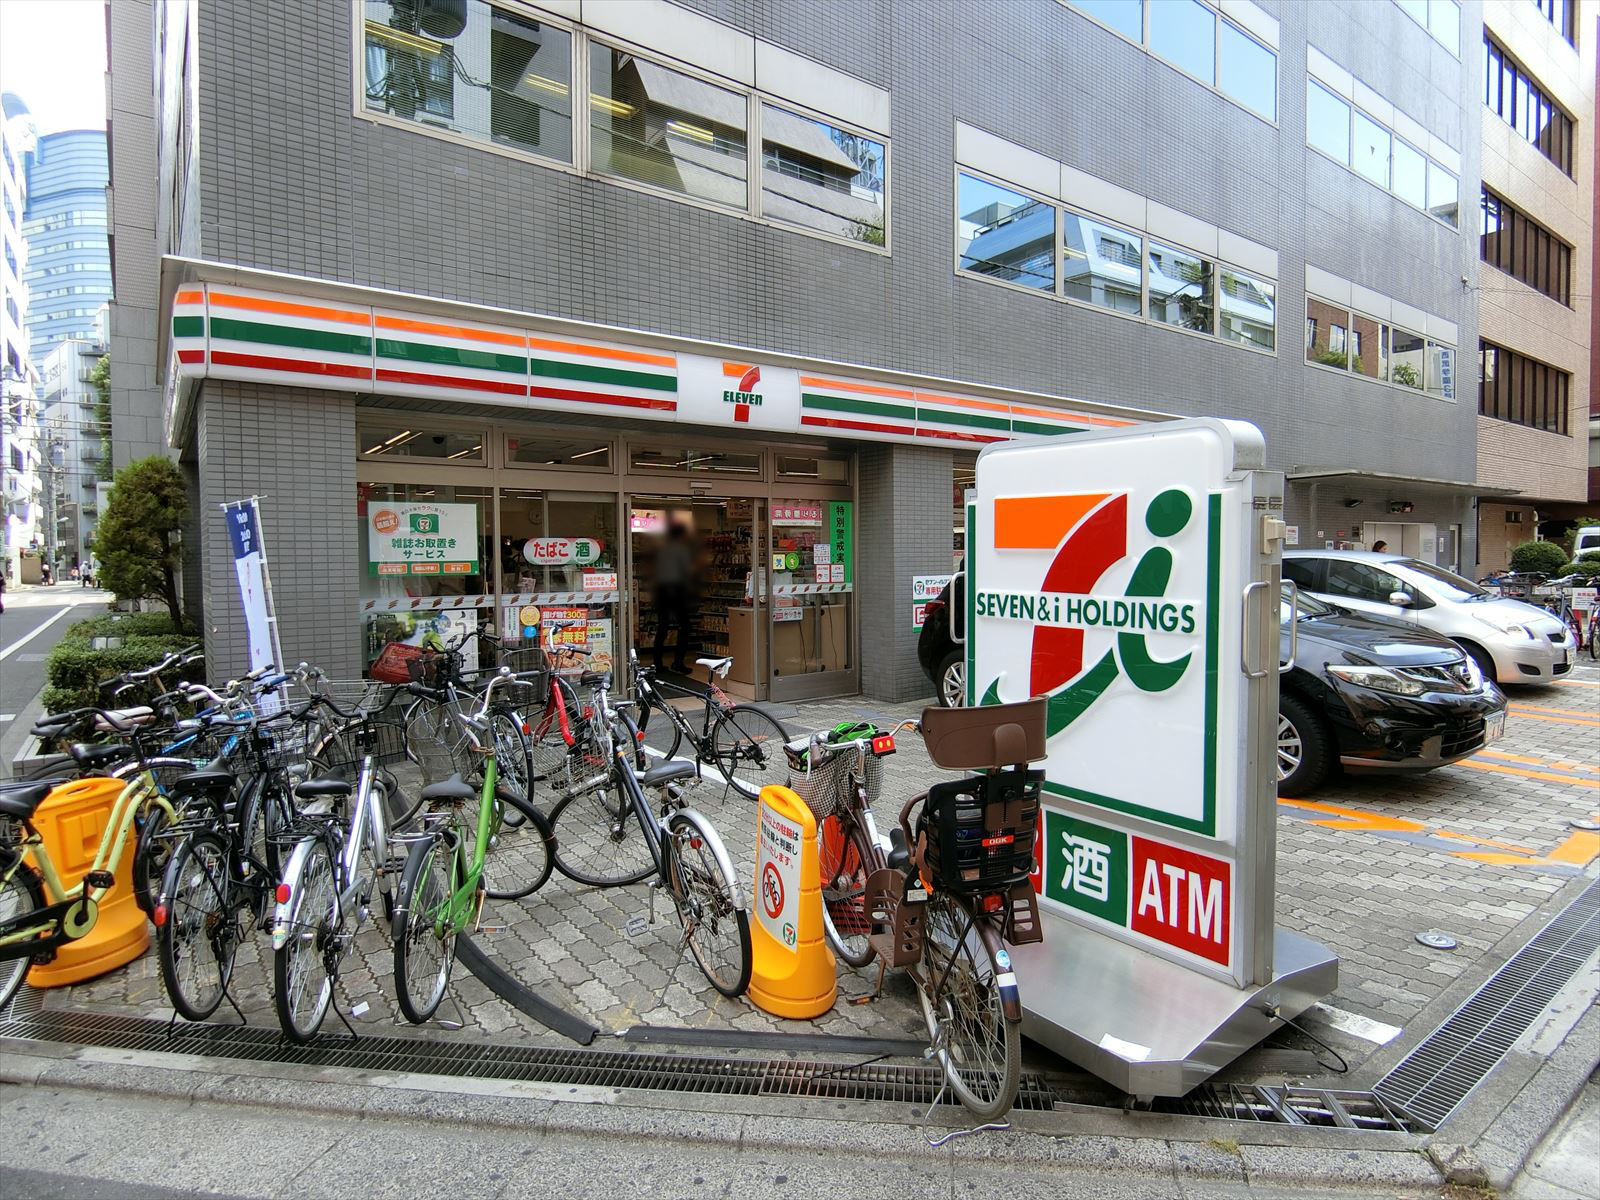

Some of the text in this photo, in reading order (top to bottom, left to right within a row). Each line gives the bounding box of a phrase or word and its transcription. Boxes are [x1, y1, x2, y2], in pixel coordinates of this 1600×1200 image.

[391, 538, 457, 549] 雑誌お取置き
[403, 550, 446, 559] サービス
[533, 542, 590, 557] たばこ 酒
[1067, 597, 1196, 634] HOLDINGS
[1061, 831, 1111, 902] 酒
[1138, 858, 1223, 944] ATM
